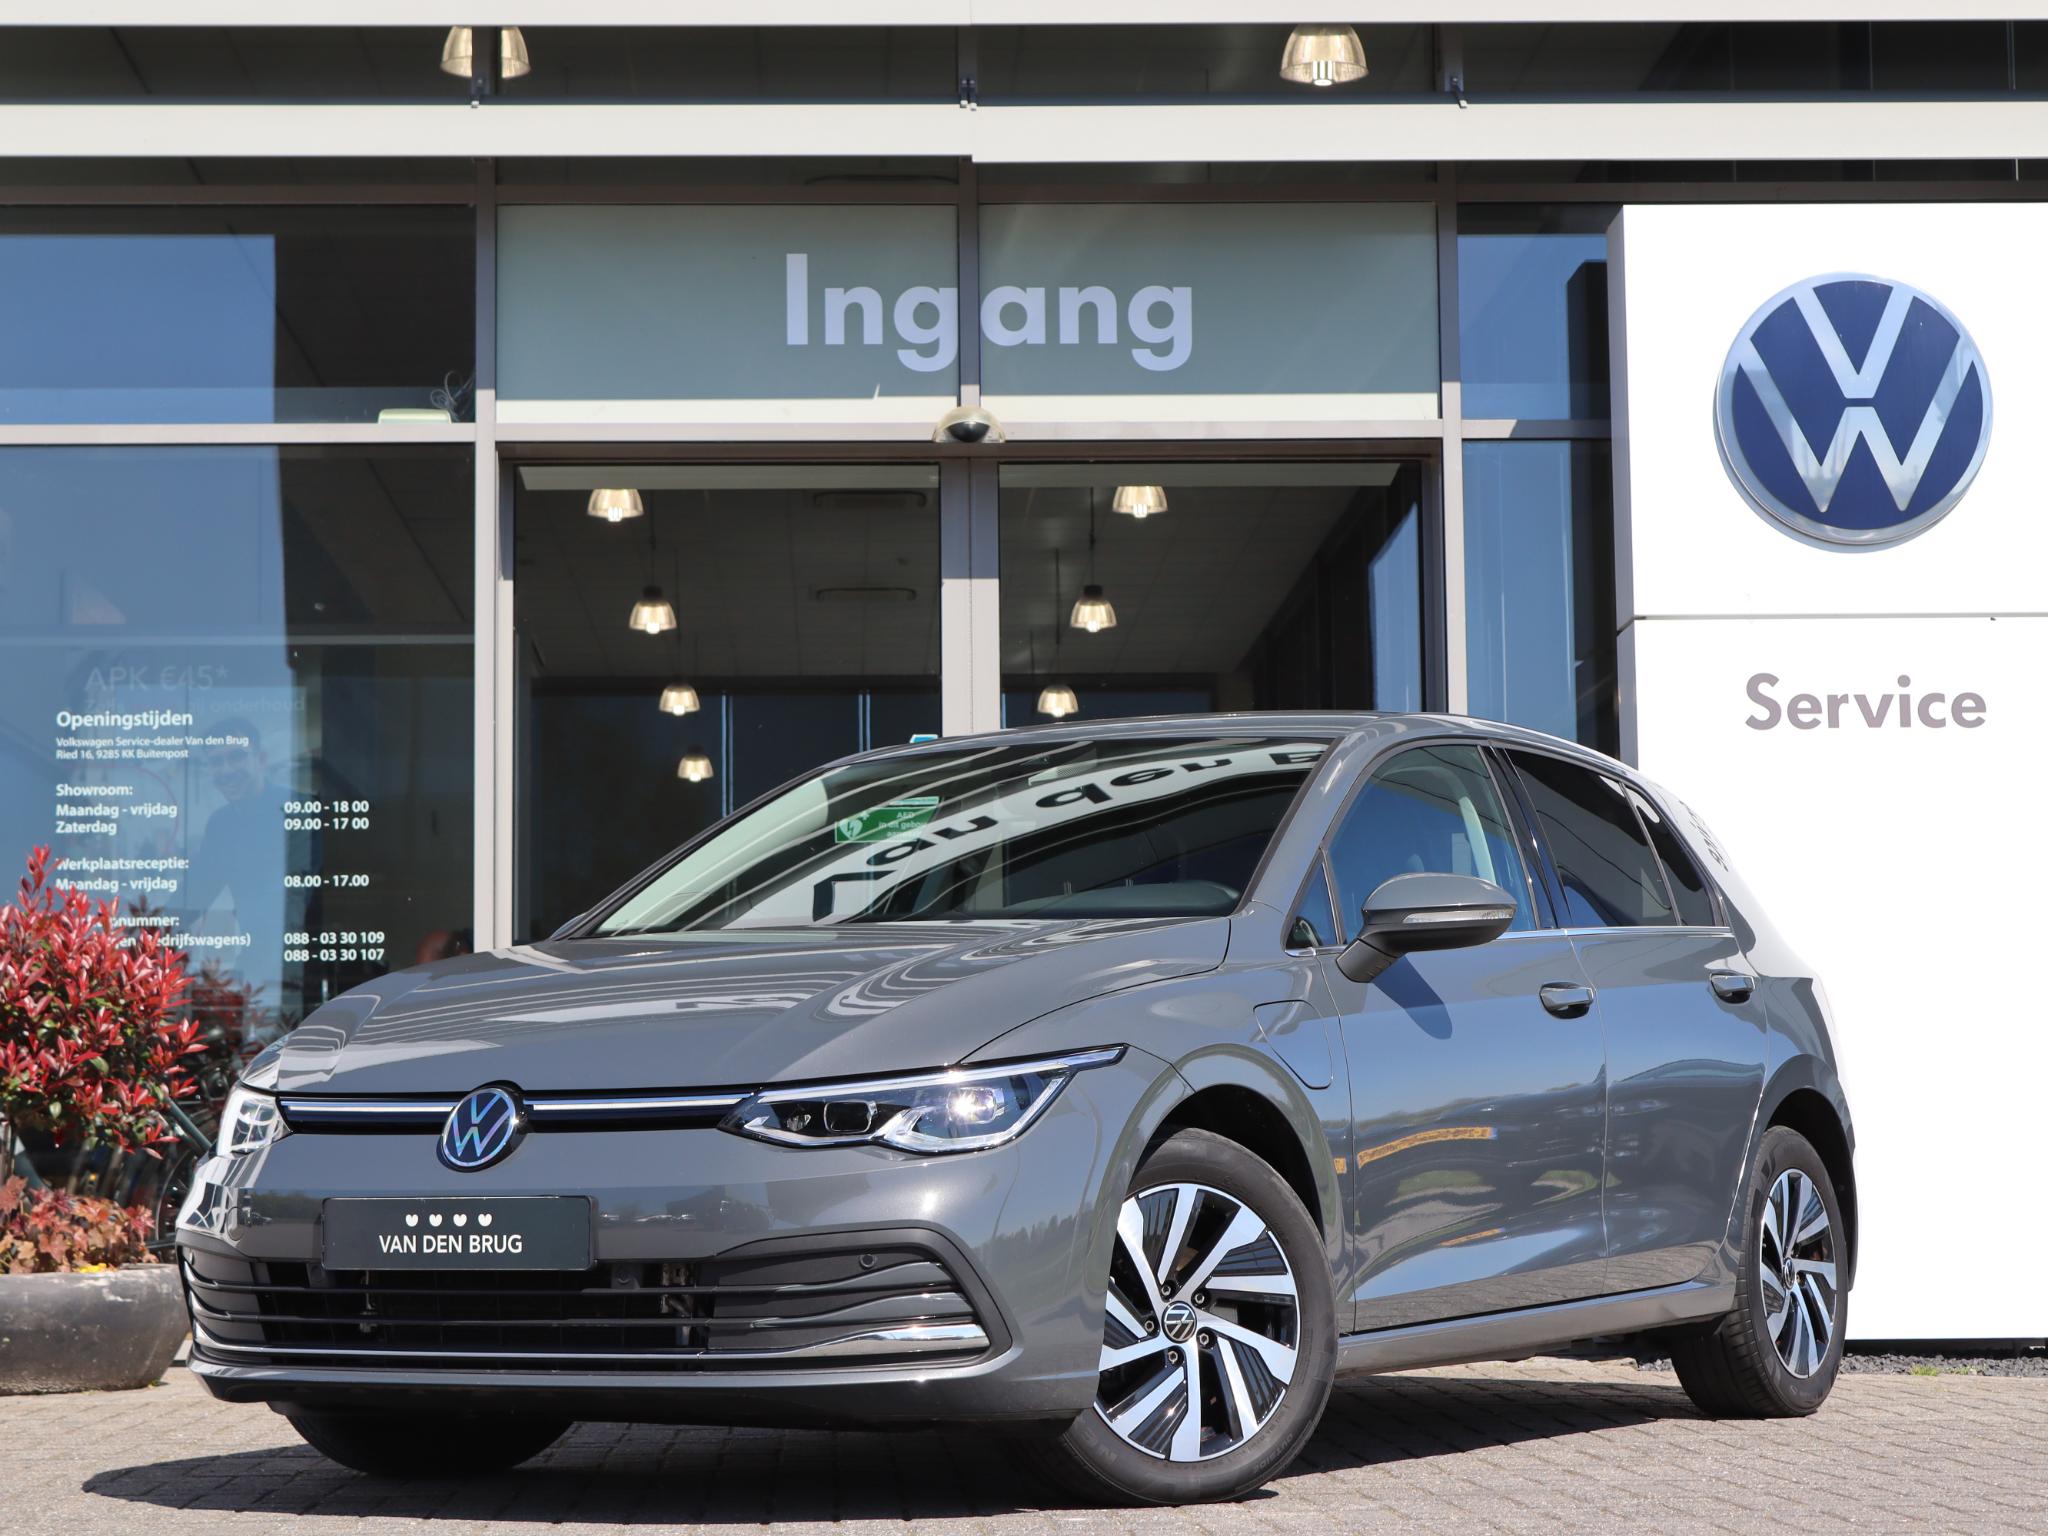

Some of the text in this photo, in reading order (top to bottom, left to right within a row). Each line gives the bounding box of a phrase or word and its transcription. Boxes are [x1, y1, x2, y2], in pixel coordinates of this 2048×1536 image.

[786, 253, 1193, 372] Ingang
[85, 666, 148, 691] APK
[1745, 672, 1987, 731] Service
[56, 710, 193, 730] Openingstijden
[56, 735, 250, 748] Volkswagen Service-dealer Van den Brug
[56, 748, 189, 761] Ried 16, 9285 KK Buitenpost
[56, 784, 133, 797] Showroom:
[56, 803, 119, 818] Maandag
[130, 802, 178, 818] vrijdag
[284, 801, 322, 813] 09.00
[56, 820, 117, 835] Zaterdag
[284, 818, 322, 830] 09.00
[130, 877, 178, 892] vrijdag
[284, 875, 322, 887] 08.00
[333, 874, 370, 887] 17.00
[284, 932, 309, 945] 088
[320, 932, 338, 945] 03
[340, 932, 357, 944] 30
[360, 931, 385, 944] 109
[284, 950, 309, 962] 088
[320, 949, 338, 962] 03
[340, 949, 357, 961] 30
[360, 948, 385, 961] 107
[379, 1234, 523, 1253] VAN DEN BRUG
